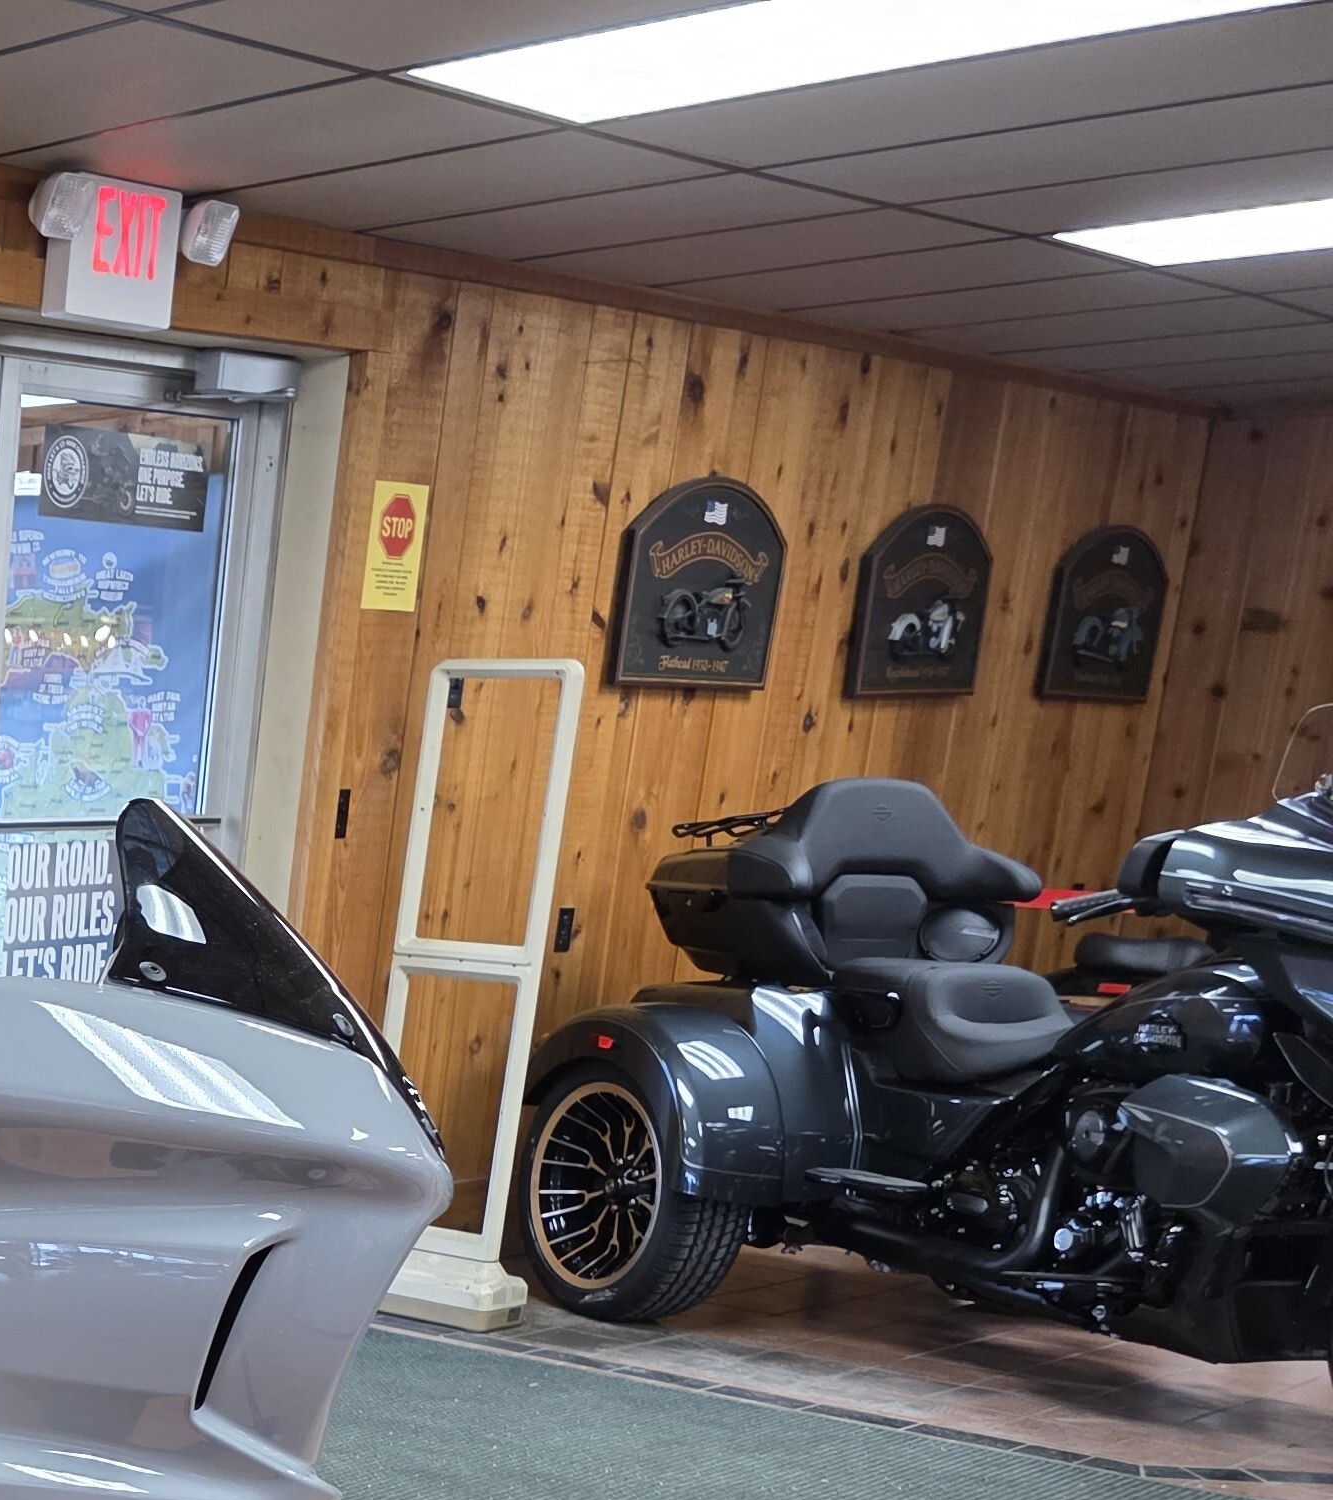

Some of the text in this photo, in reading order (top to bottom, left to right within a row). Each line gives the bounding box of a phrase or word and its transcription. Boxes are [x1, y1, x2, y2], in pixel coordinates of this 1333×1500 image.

[92, 185, 167, 282] EXIT
[136, 484, 155, 502] LET'S
[381, 516, 413, 539] STOP
[662, 538, 756, 581] HARLEY-DAVIDSON
[7, 839, 112, 891] OUR ROAD.
[4, 890, 117, 944] OUR RULES.
